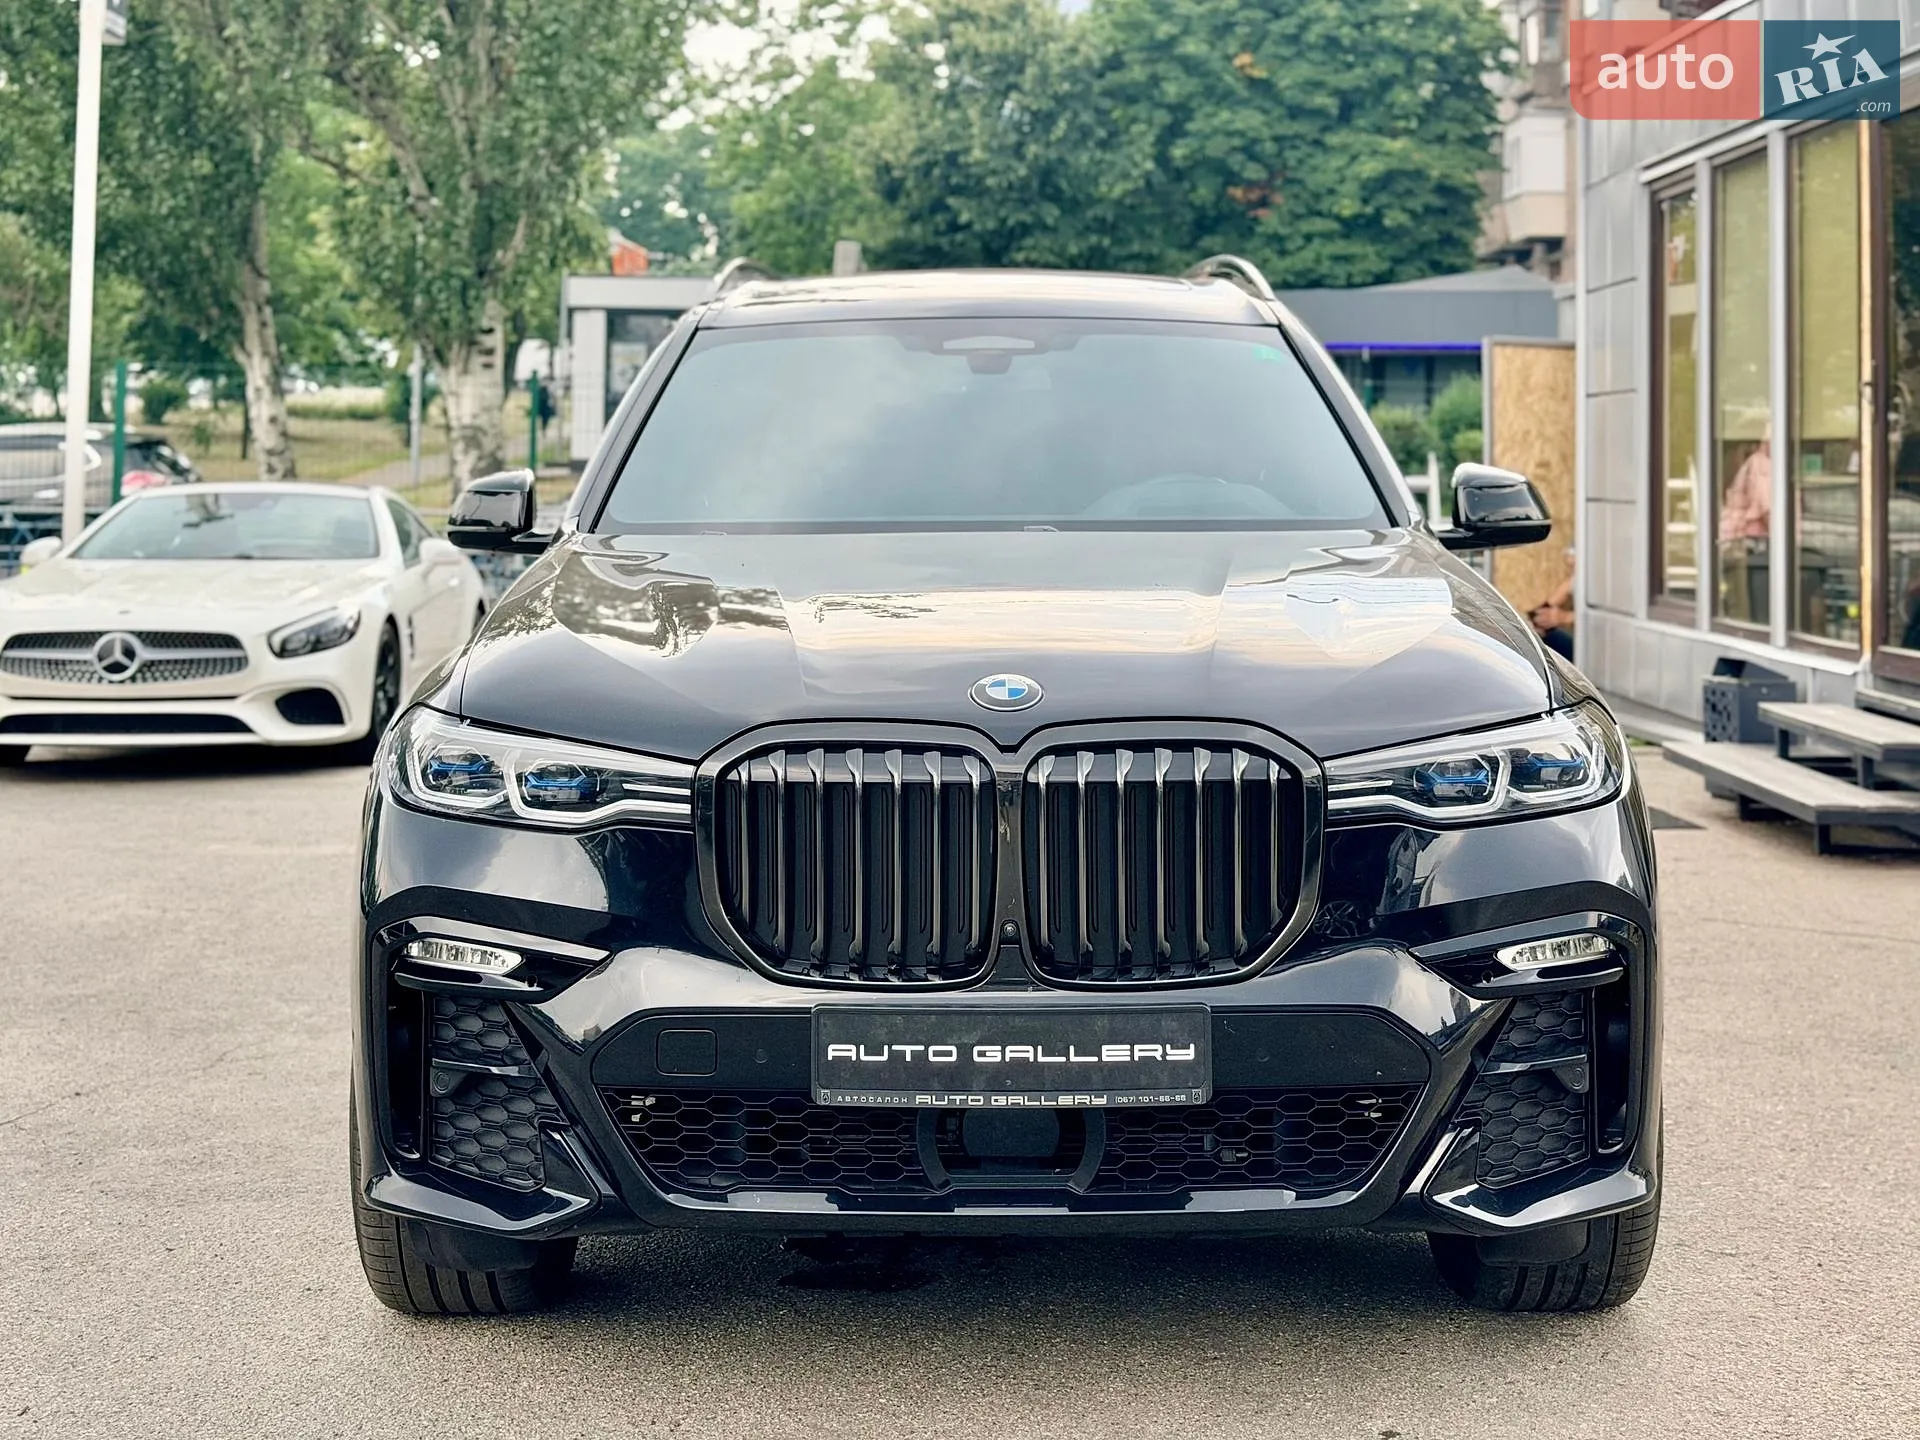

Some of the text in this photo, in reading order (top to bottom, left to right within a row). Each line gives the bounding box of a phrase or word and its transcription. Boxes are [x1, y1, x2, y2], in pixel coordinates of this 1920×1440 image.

[827, 1044, 1195, 1062] AUTO GALLERY
[915, 1095, 985, 1105] AUTO
[991, 1094, 1107, 1105] GALLERY
